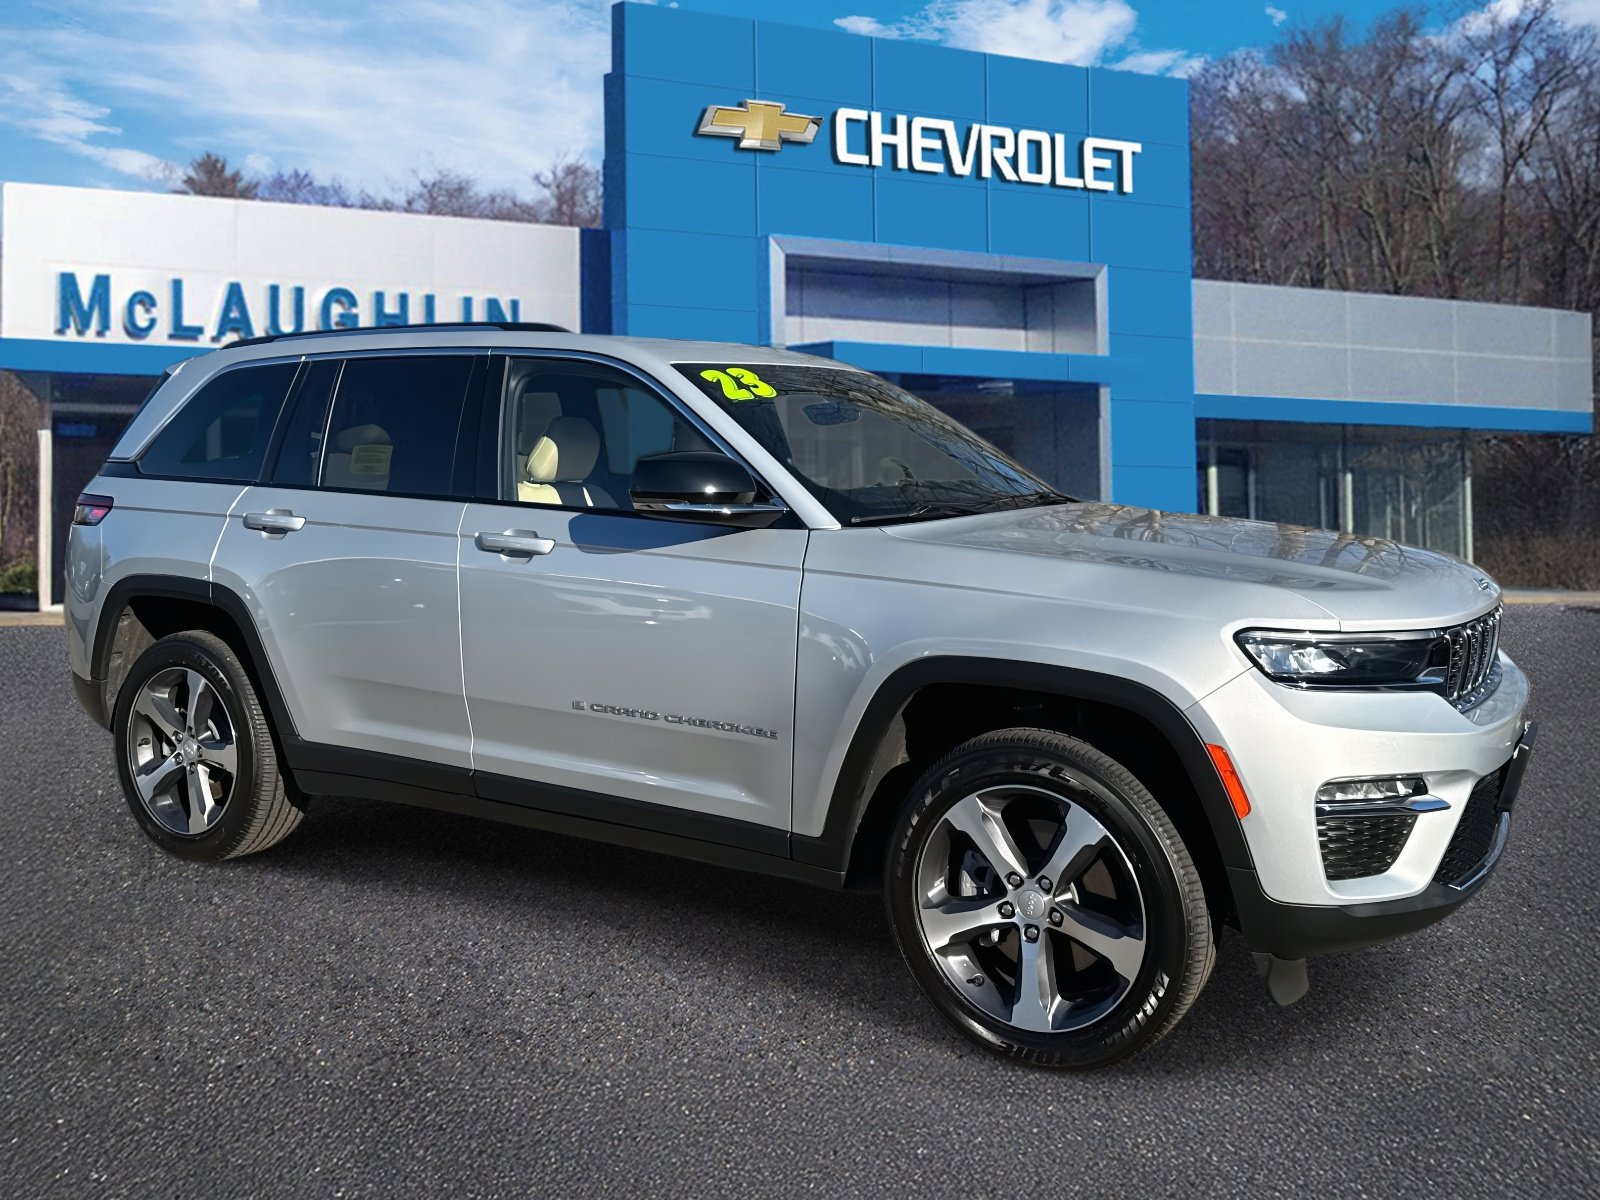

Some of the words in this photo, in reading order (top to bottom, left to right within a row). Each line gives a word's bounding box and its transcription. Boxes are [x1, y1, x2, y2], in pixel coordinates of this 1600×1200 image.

[834, 107, 1142, 193] CHEVROLET
[700, 367, 778, 402] 23
[589, 703, 660, 720] GRAND
[663, 713, 779, 740] CHEROKEE
